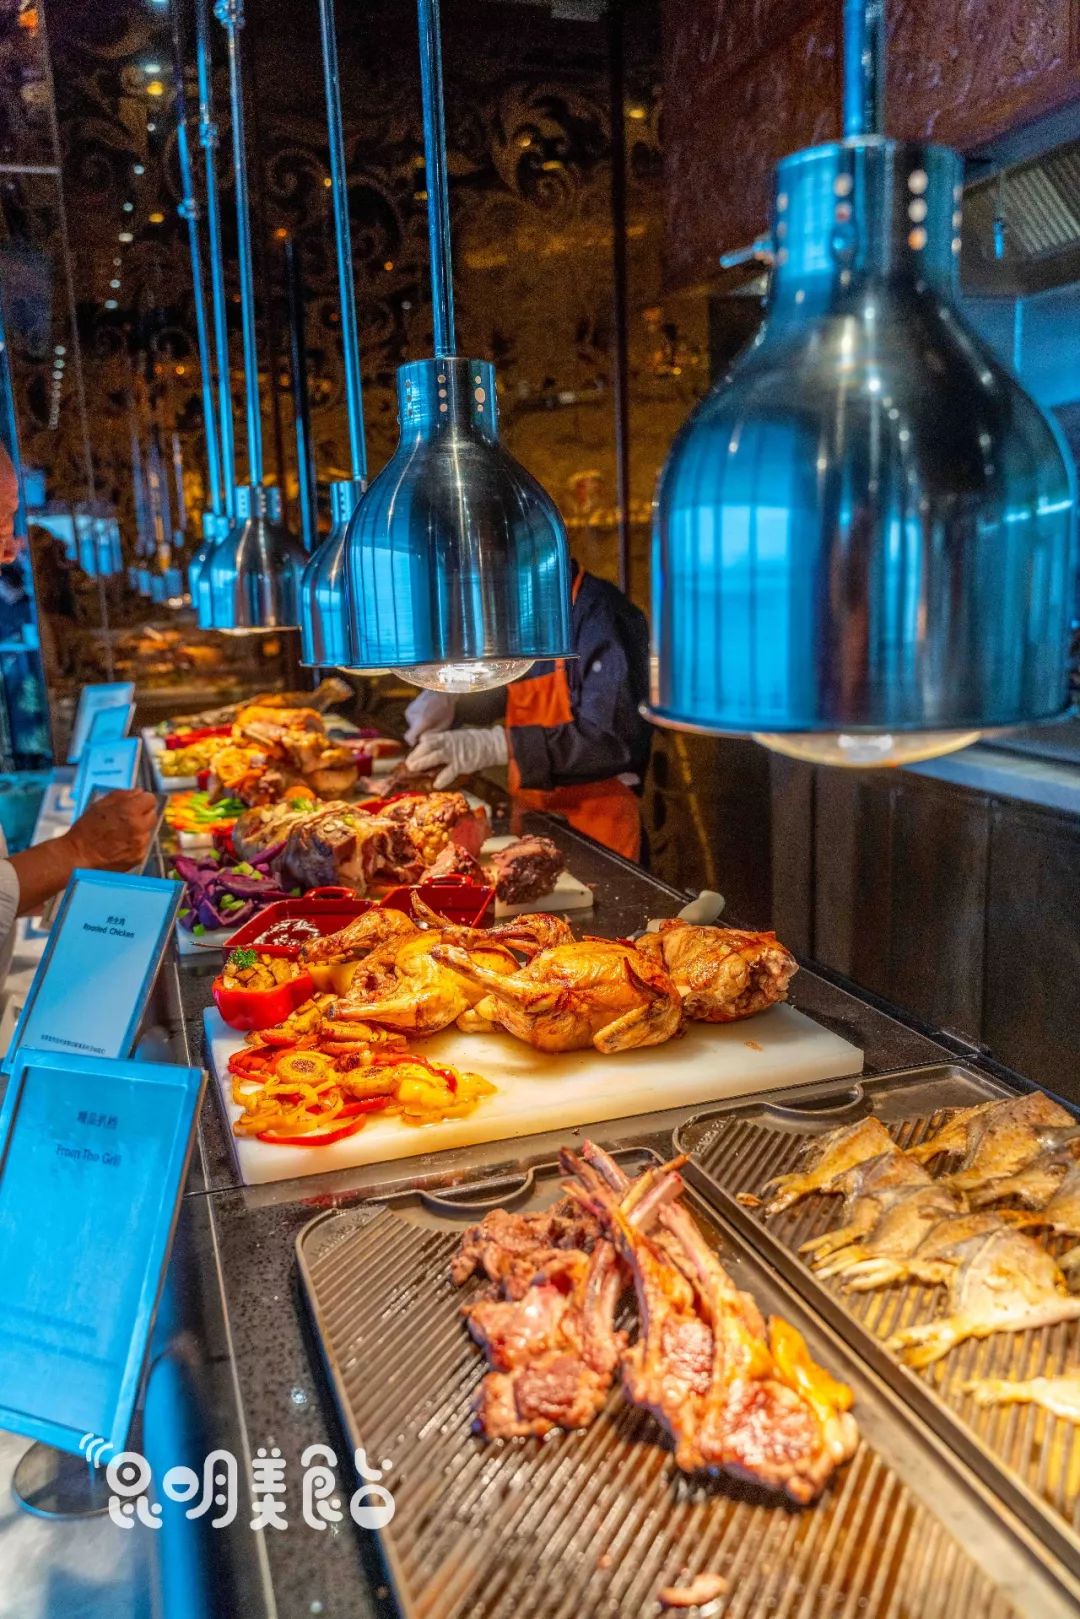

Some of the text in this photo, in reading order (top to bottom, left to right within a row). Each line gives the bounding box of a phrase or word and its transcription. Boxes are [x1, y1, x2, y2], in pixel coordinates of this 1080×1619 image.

[83, 923, 135, 938] Roasted Chicken
[56, 1144, 81, 1160] From
